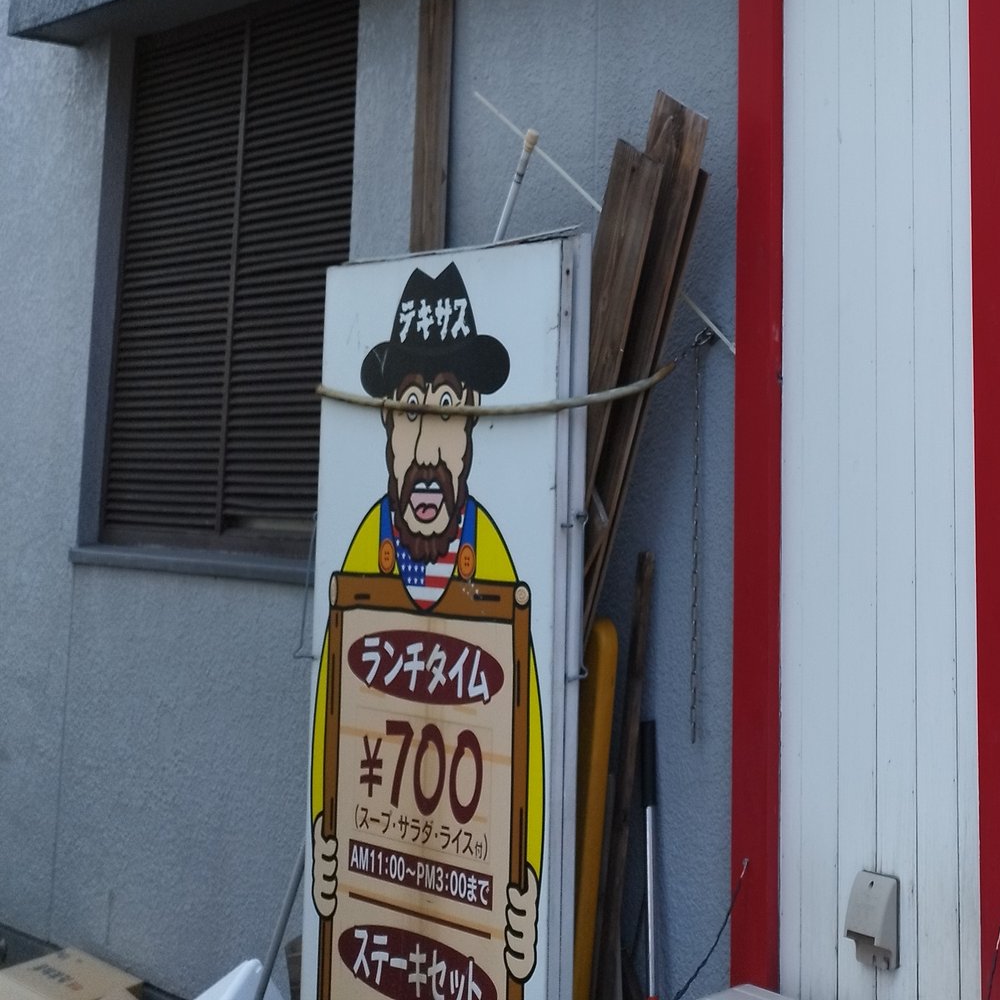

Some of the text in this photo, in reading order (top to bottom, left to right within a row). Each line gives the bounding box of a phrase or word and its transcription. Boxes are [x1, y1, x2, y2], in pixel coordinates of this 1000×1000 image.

[399, 297, 471, 343] テキサス
[361, 636, 491, 701] ランチタイム
[359, 719, 483, 825] ¥700
[353, 928, 482, 1000] ステーキセット
